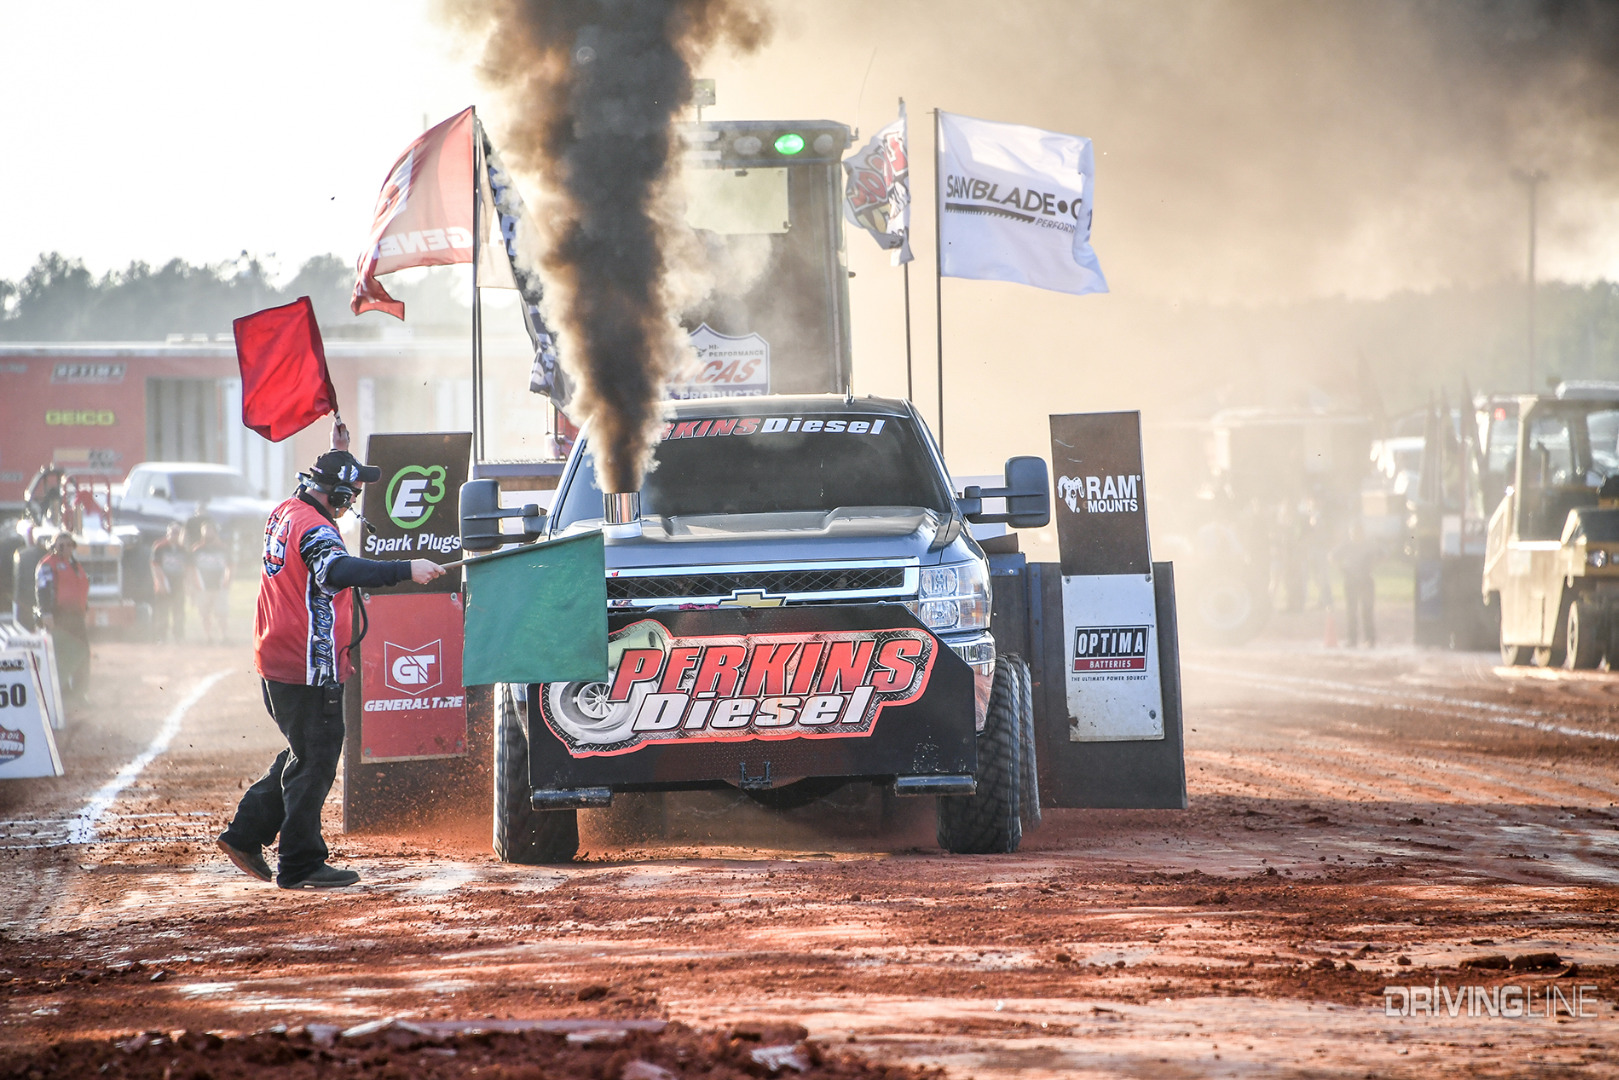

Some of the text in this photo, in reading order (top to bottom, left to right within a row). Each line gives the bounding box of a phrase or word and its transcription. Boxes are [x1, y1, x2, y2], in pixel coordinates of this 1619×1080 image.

[708, 349, 765, 358] PERFORMANCE
[45, 409, 115, 426] GEICO
[760, 417, 886, 436] Diesel
[1087, 499, 1139, 513] MOUNTS
[364, 532, 462, 555] Spark Plugs
[313, 594, 334, 668] UCAS OIL
[1077, 632, 1145, 655] OPTIMA
[391, 654, 436, 685] GT
[605, 637, 926, 703] PERKINS
[1089, 660, 1132, 669] BATTERIES
[364, 696, 464, 712] GENERAL TIRE
[631, 685, 877, 733] Diesel
